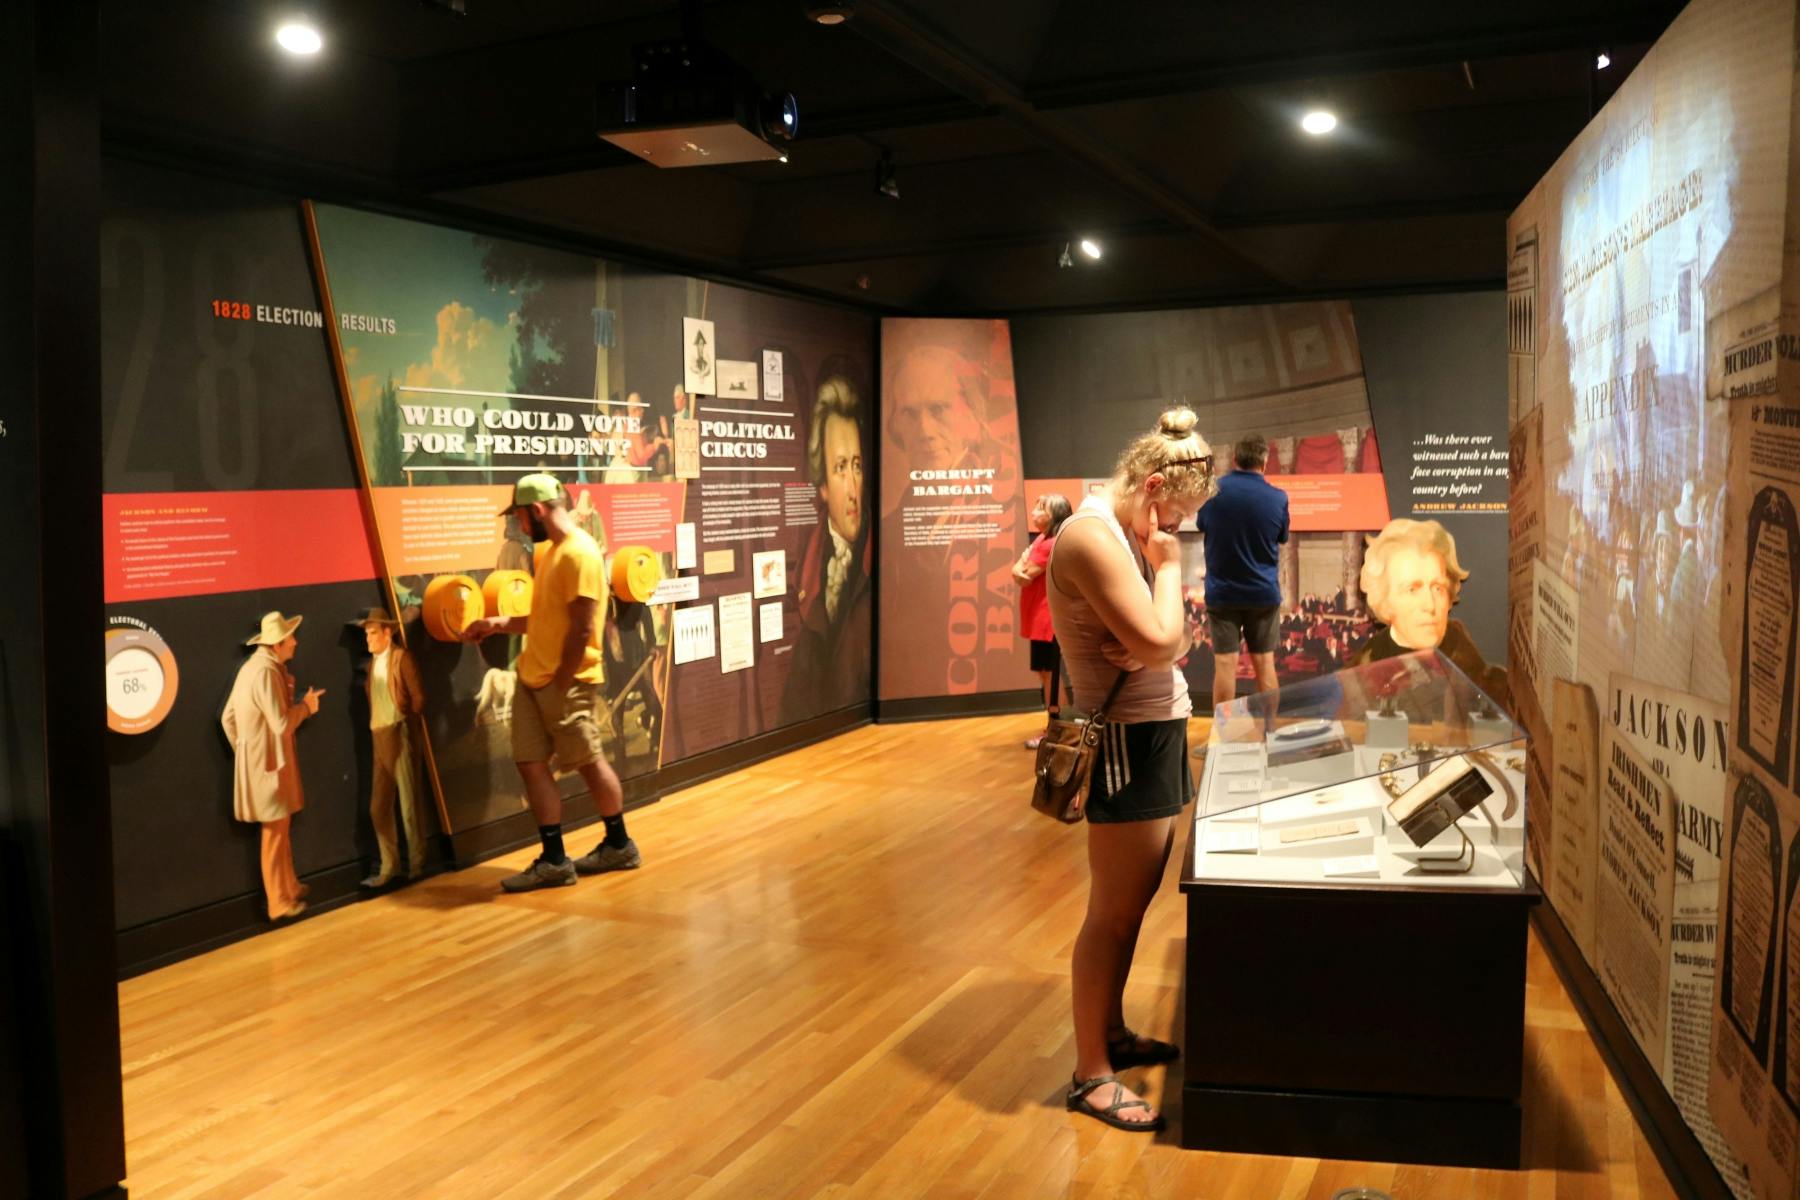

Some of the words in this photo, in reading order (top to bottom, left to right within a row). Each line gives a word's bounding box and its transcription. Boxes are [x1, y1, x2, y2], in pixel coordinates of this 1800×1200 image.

[211, 299, 252, 321] 1828
[256, 305, 323, 328] ELECTION
[341, 313, 397, 335] RESULTS
[1724, 339, 1773, 377] MURDER
[399, 404, 476, 428] WHO
[483, 408, 574, 432] COULD
[580, 414, 641, 434] VOTE
[700, 421, 795, 440] POLITICAL
[1445, 433, 1469, 445] there
[1470, 435, 1493, 444] ever
[401, 432, 465, 454] FOR
[474, 433, 632, 457] PRESIDENT?
[701, 442, 768, 459] CIRCUS
[1412, 450, 1459, 462] witnessed
[1459, 450, 1480, 461] such
[1481, 452, 1488, 460] a
[909, 468, 996, 481] CORRUPT
[1410, 466, 1431, 480] face
[1432, 465, 1481, 480] corruption
[1483, 466, 1493, 477] in
[913, 484, 994, 497] BARGAIN
[1412, 485, 1448, 498] country
[1449, 483, 1483, 498] before?
[1413, 502, 1457, 510] ANDREW
[1459, 502, 1508, 510] JACKSON
[1613, 688, 1728, 773] JACKSON
[1607, 767, 1626, 804] Read
[1626, 791, 1634, 813] &
[1611, 741, 1662, 817] IRISHMEN
[1677, 800, 1724, 860] ARMY
[1601, 841, 1628, 888] ANDREW
